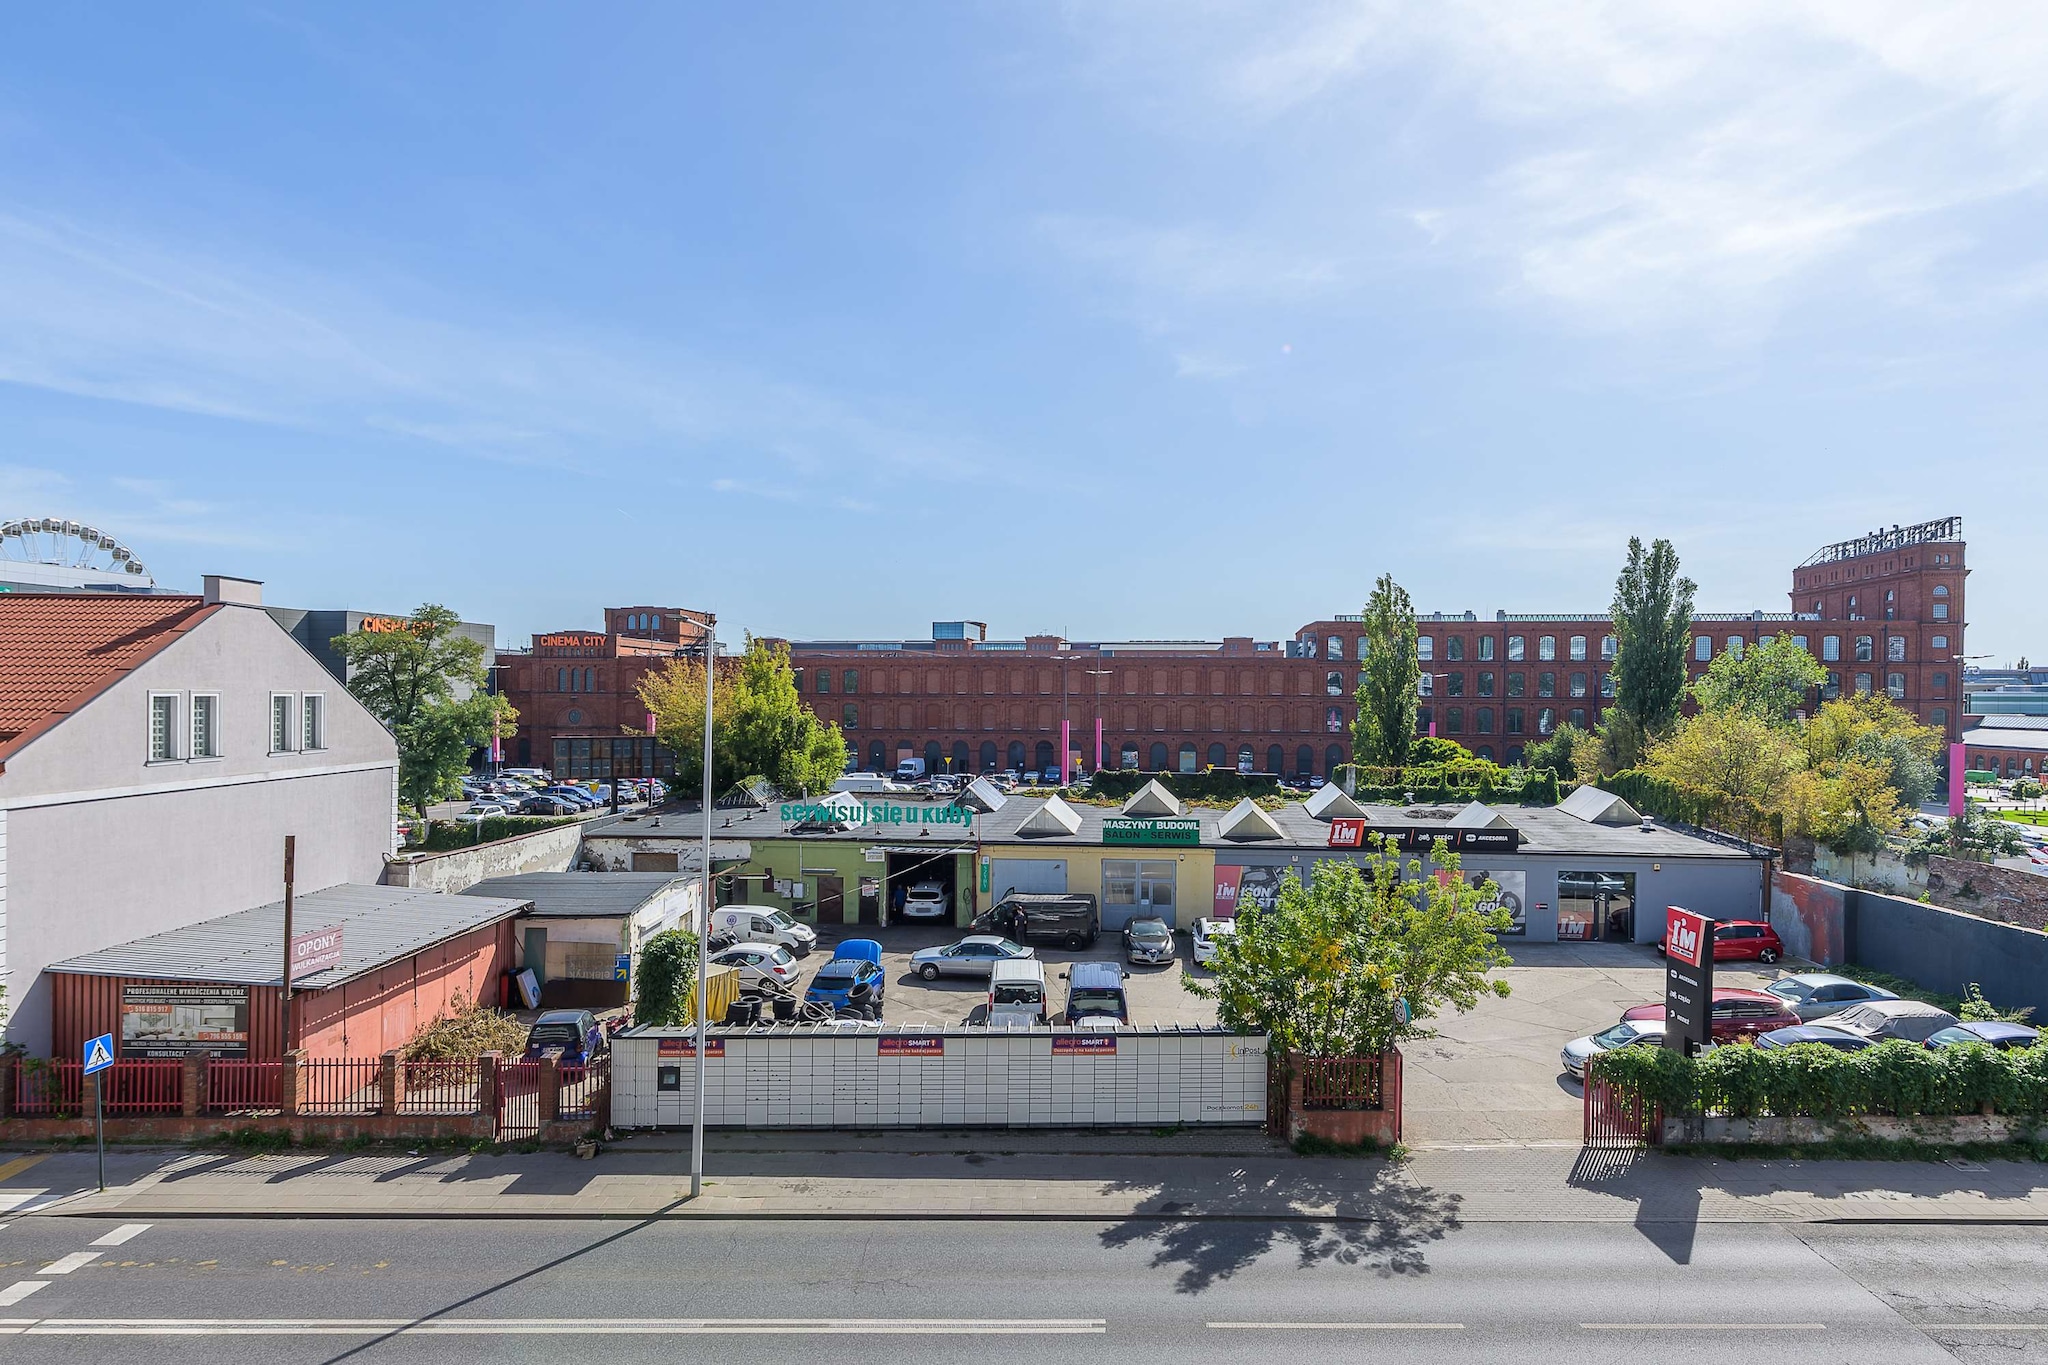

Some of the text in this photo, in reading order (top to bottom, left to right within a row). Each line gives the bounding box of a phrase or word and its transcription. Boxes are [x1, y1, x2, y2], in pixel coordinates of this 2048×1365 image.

[540, 636, 606, 646] CINEMA CITY
[780, 800, 868, 826] serwisuj
[871, 801, 901, 826] się
[906, 807, 917, 823] u
[1103, 820, 1199, 830] MASZYNY BUDOWL
[1151, 831, 1191, 839] SERWIS
[298, 933, 336, 956] OPONY
[292, 951, 340, 971] WULKANIZACJA
[1237, 1047, 1260, 1055] InPost
